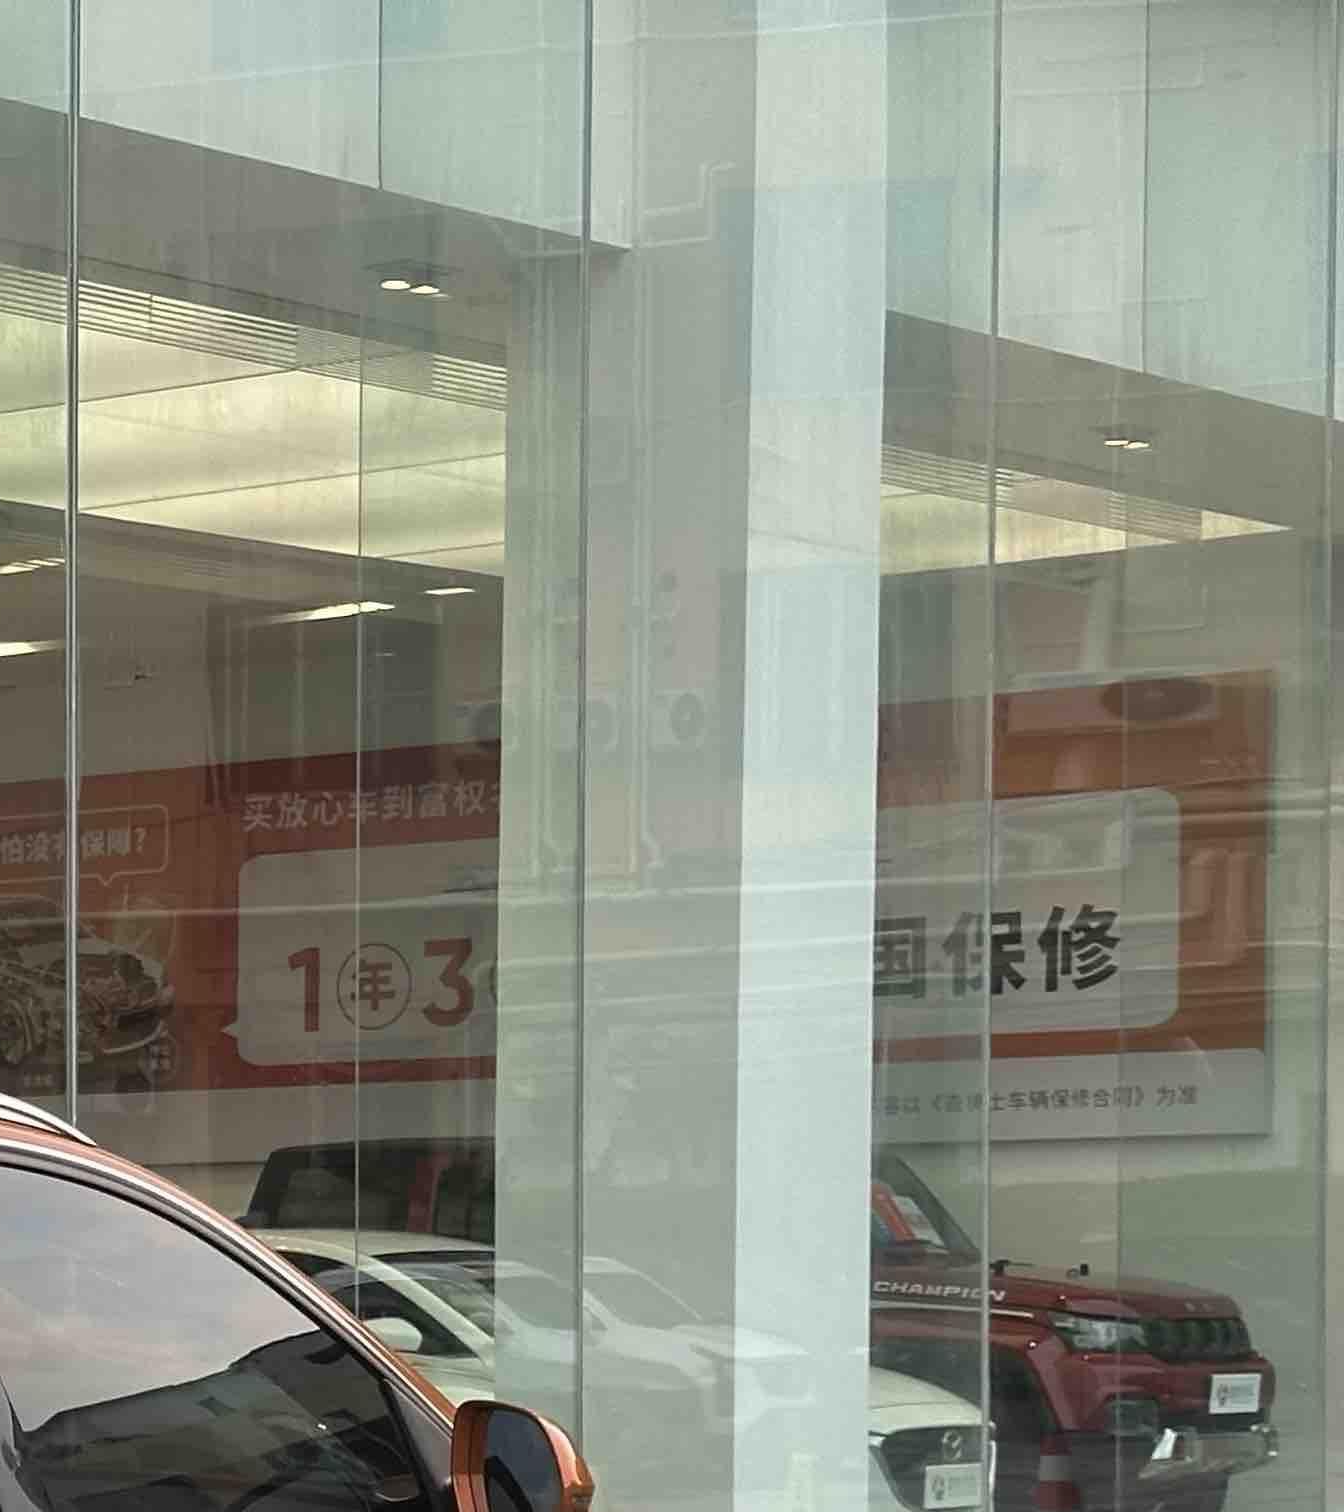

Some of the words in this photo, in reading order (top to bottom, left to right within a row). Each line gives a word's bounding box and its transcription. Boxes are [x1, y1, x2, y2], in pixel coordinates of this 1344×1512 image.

[241, 779, 500, 832] 买放心车到富权
[873, 1281, 1006, 1301] CHAMPION
